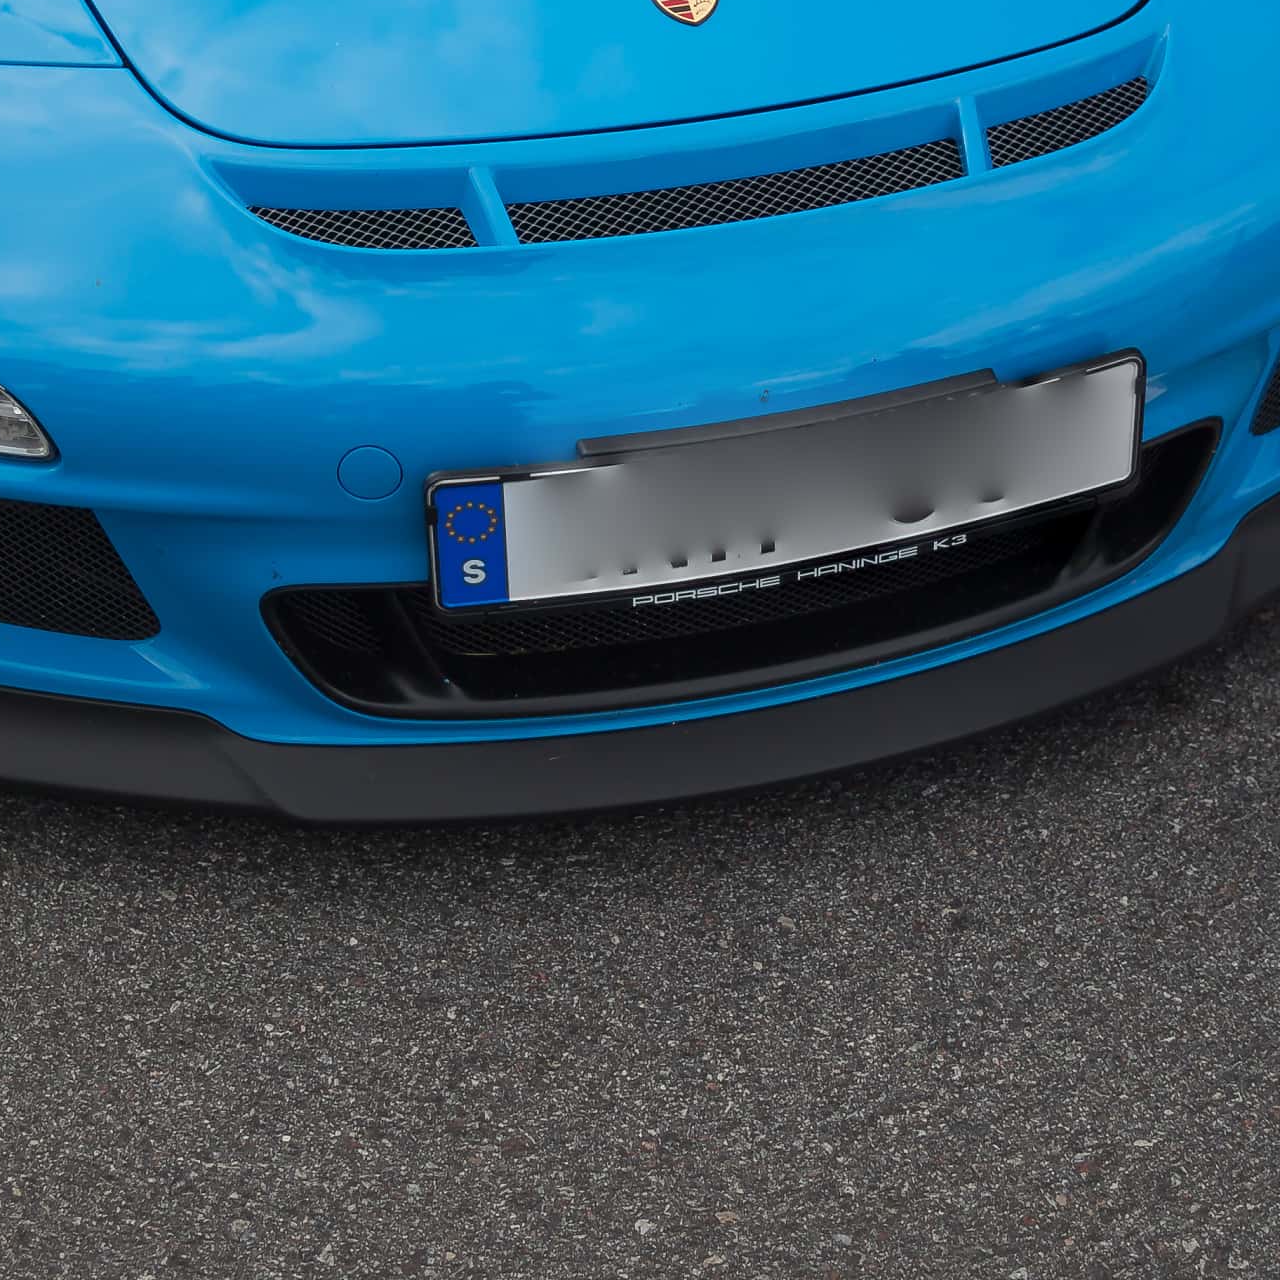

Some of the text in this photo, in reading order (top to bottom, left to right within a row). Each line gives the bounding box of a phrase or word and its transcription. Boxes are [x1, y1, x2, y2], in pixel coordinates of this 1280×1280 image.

[463, 558, 486, 585] S
[632, 533, 968, 608] PORSCHE HANINGE K3
